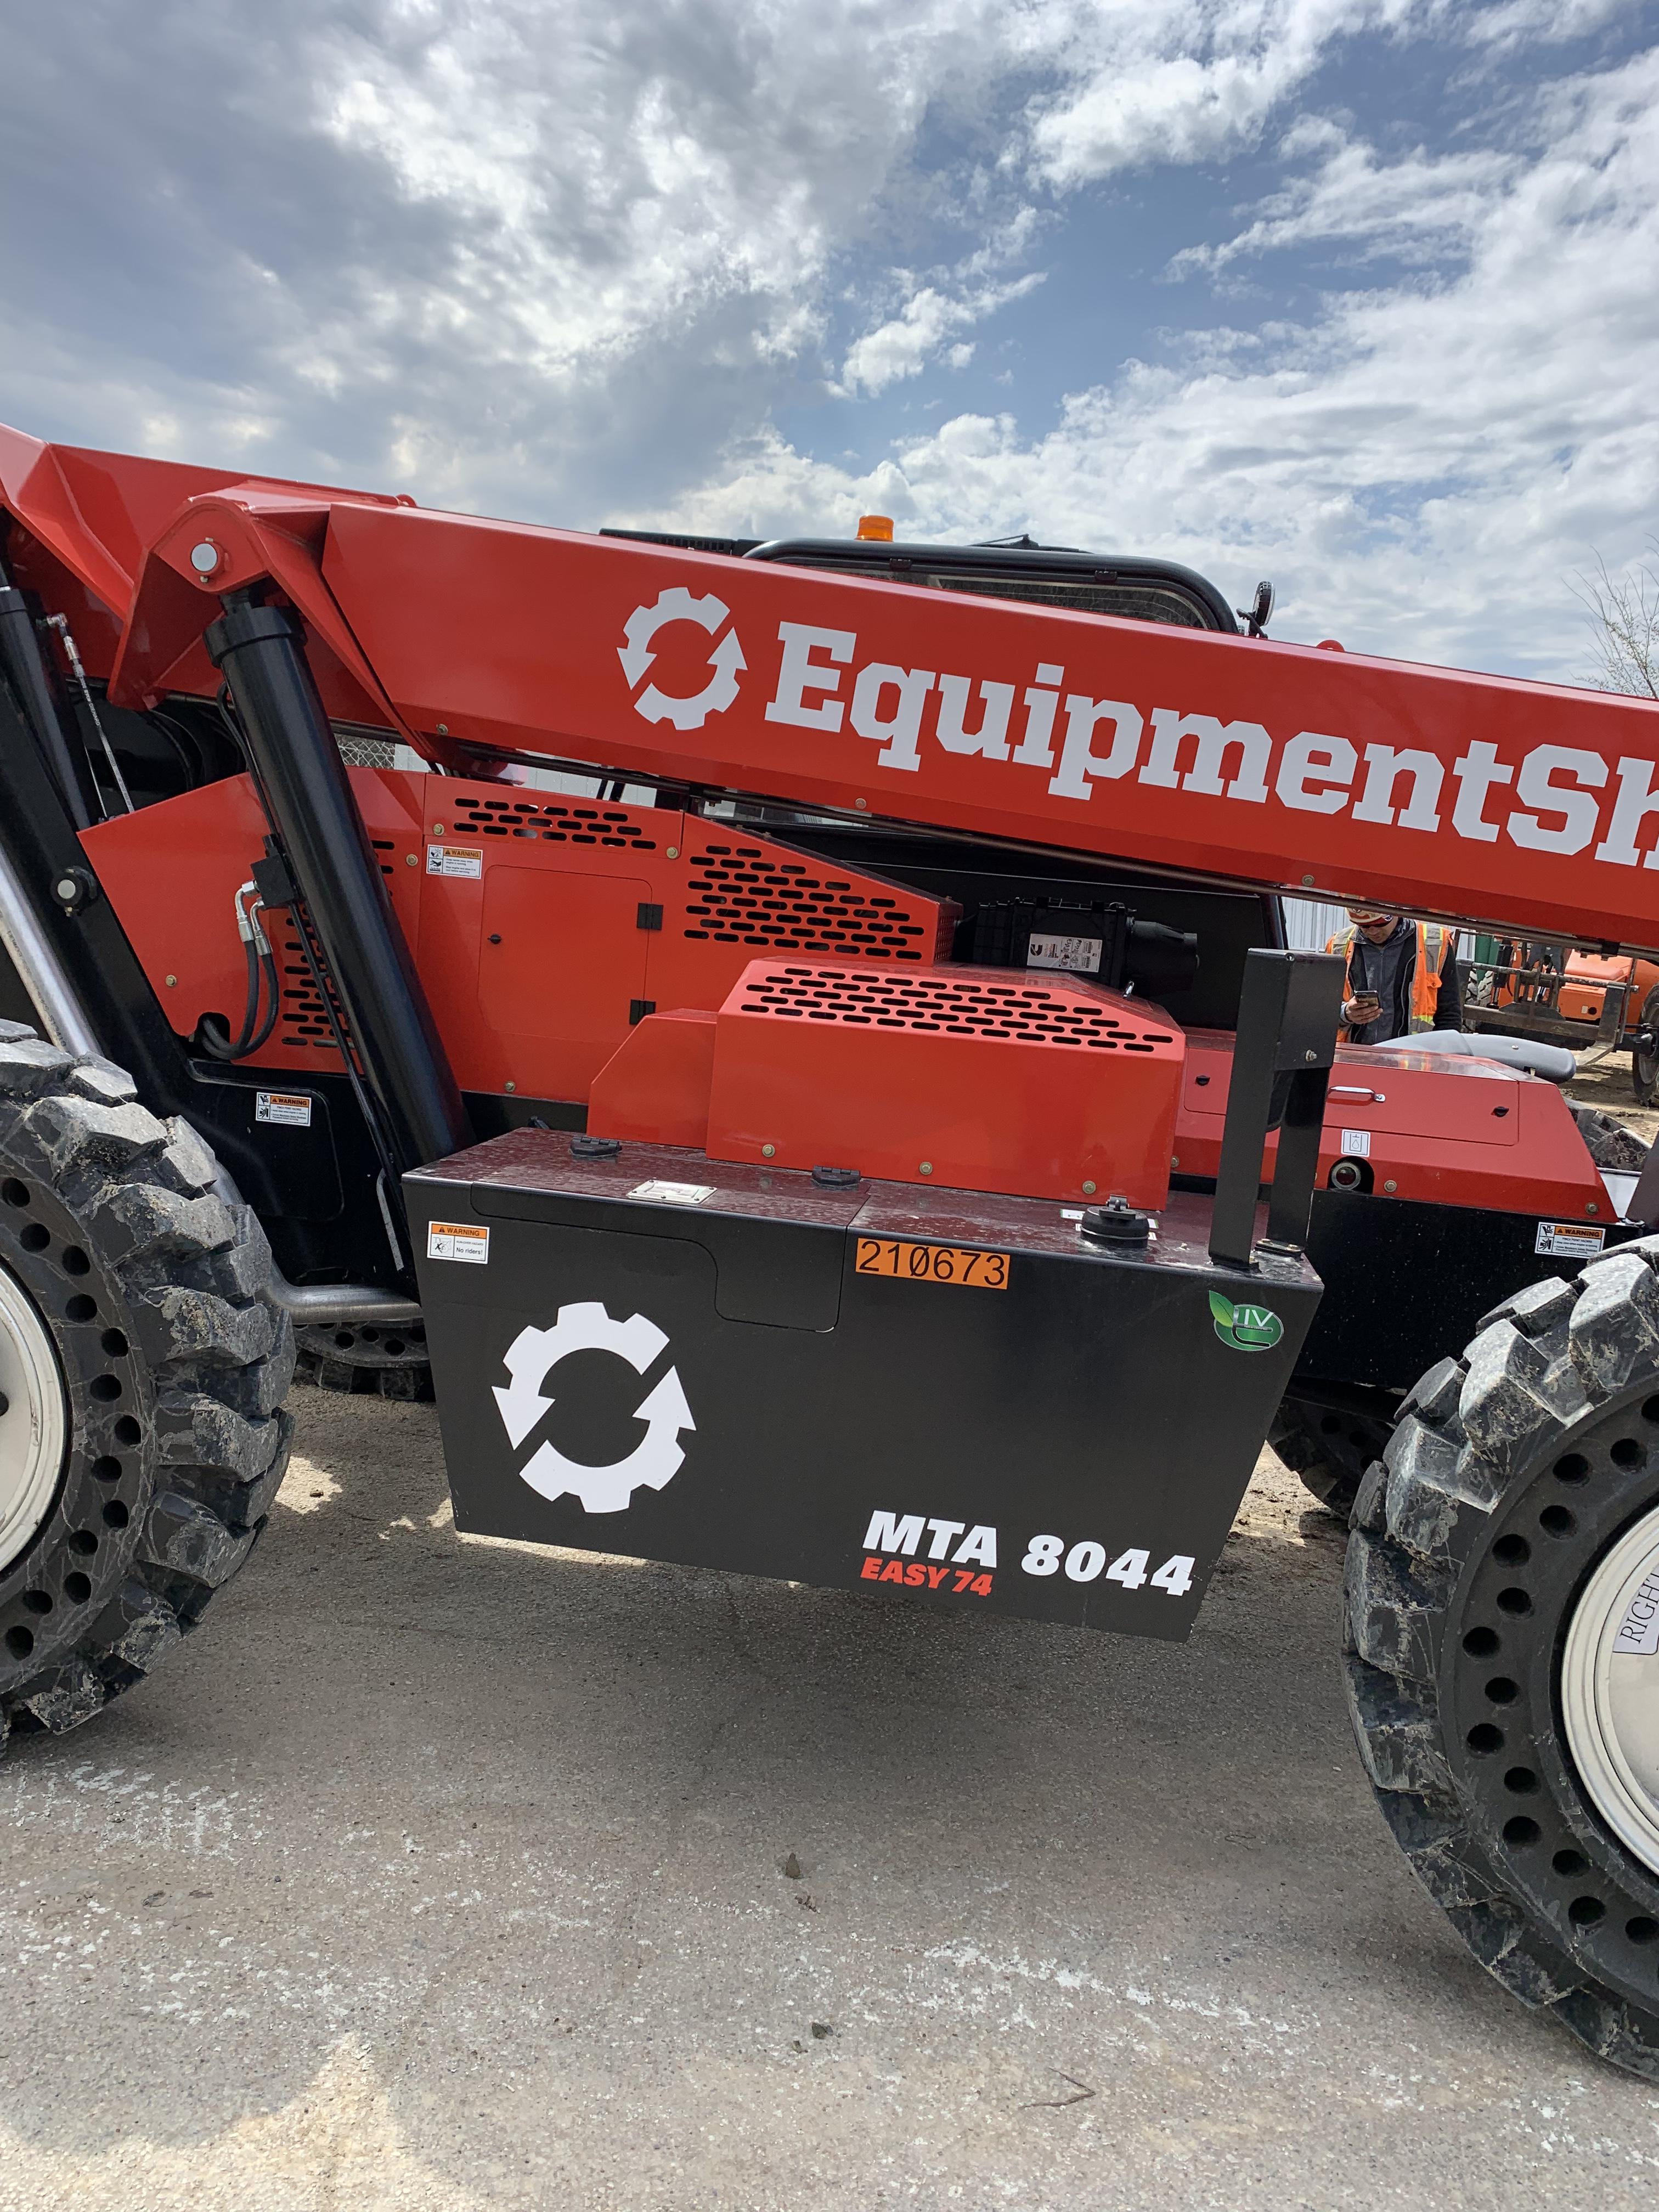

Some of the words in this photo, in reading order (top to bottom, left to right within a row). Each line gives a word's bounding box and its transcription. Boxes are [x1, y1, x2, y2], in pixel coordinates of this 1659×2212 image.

[764, 621, 1659, 871] EquipmentSh
[451, 849, 479, 857] WARNING
[447, 1227, 479, 1236] WARNING
[1565, 1228, 1600, 1238] WARNING
[859, 1240, 1005, 1286] 210673
[862, 1510, 997, 1568] MTA
[1021, 1534, 1196, 1597] 8044
[860, 1556, 950, 1589] EASY
[951, 1570, 994, 1597] 74
